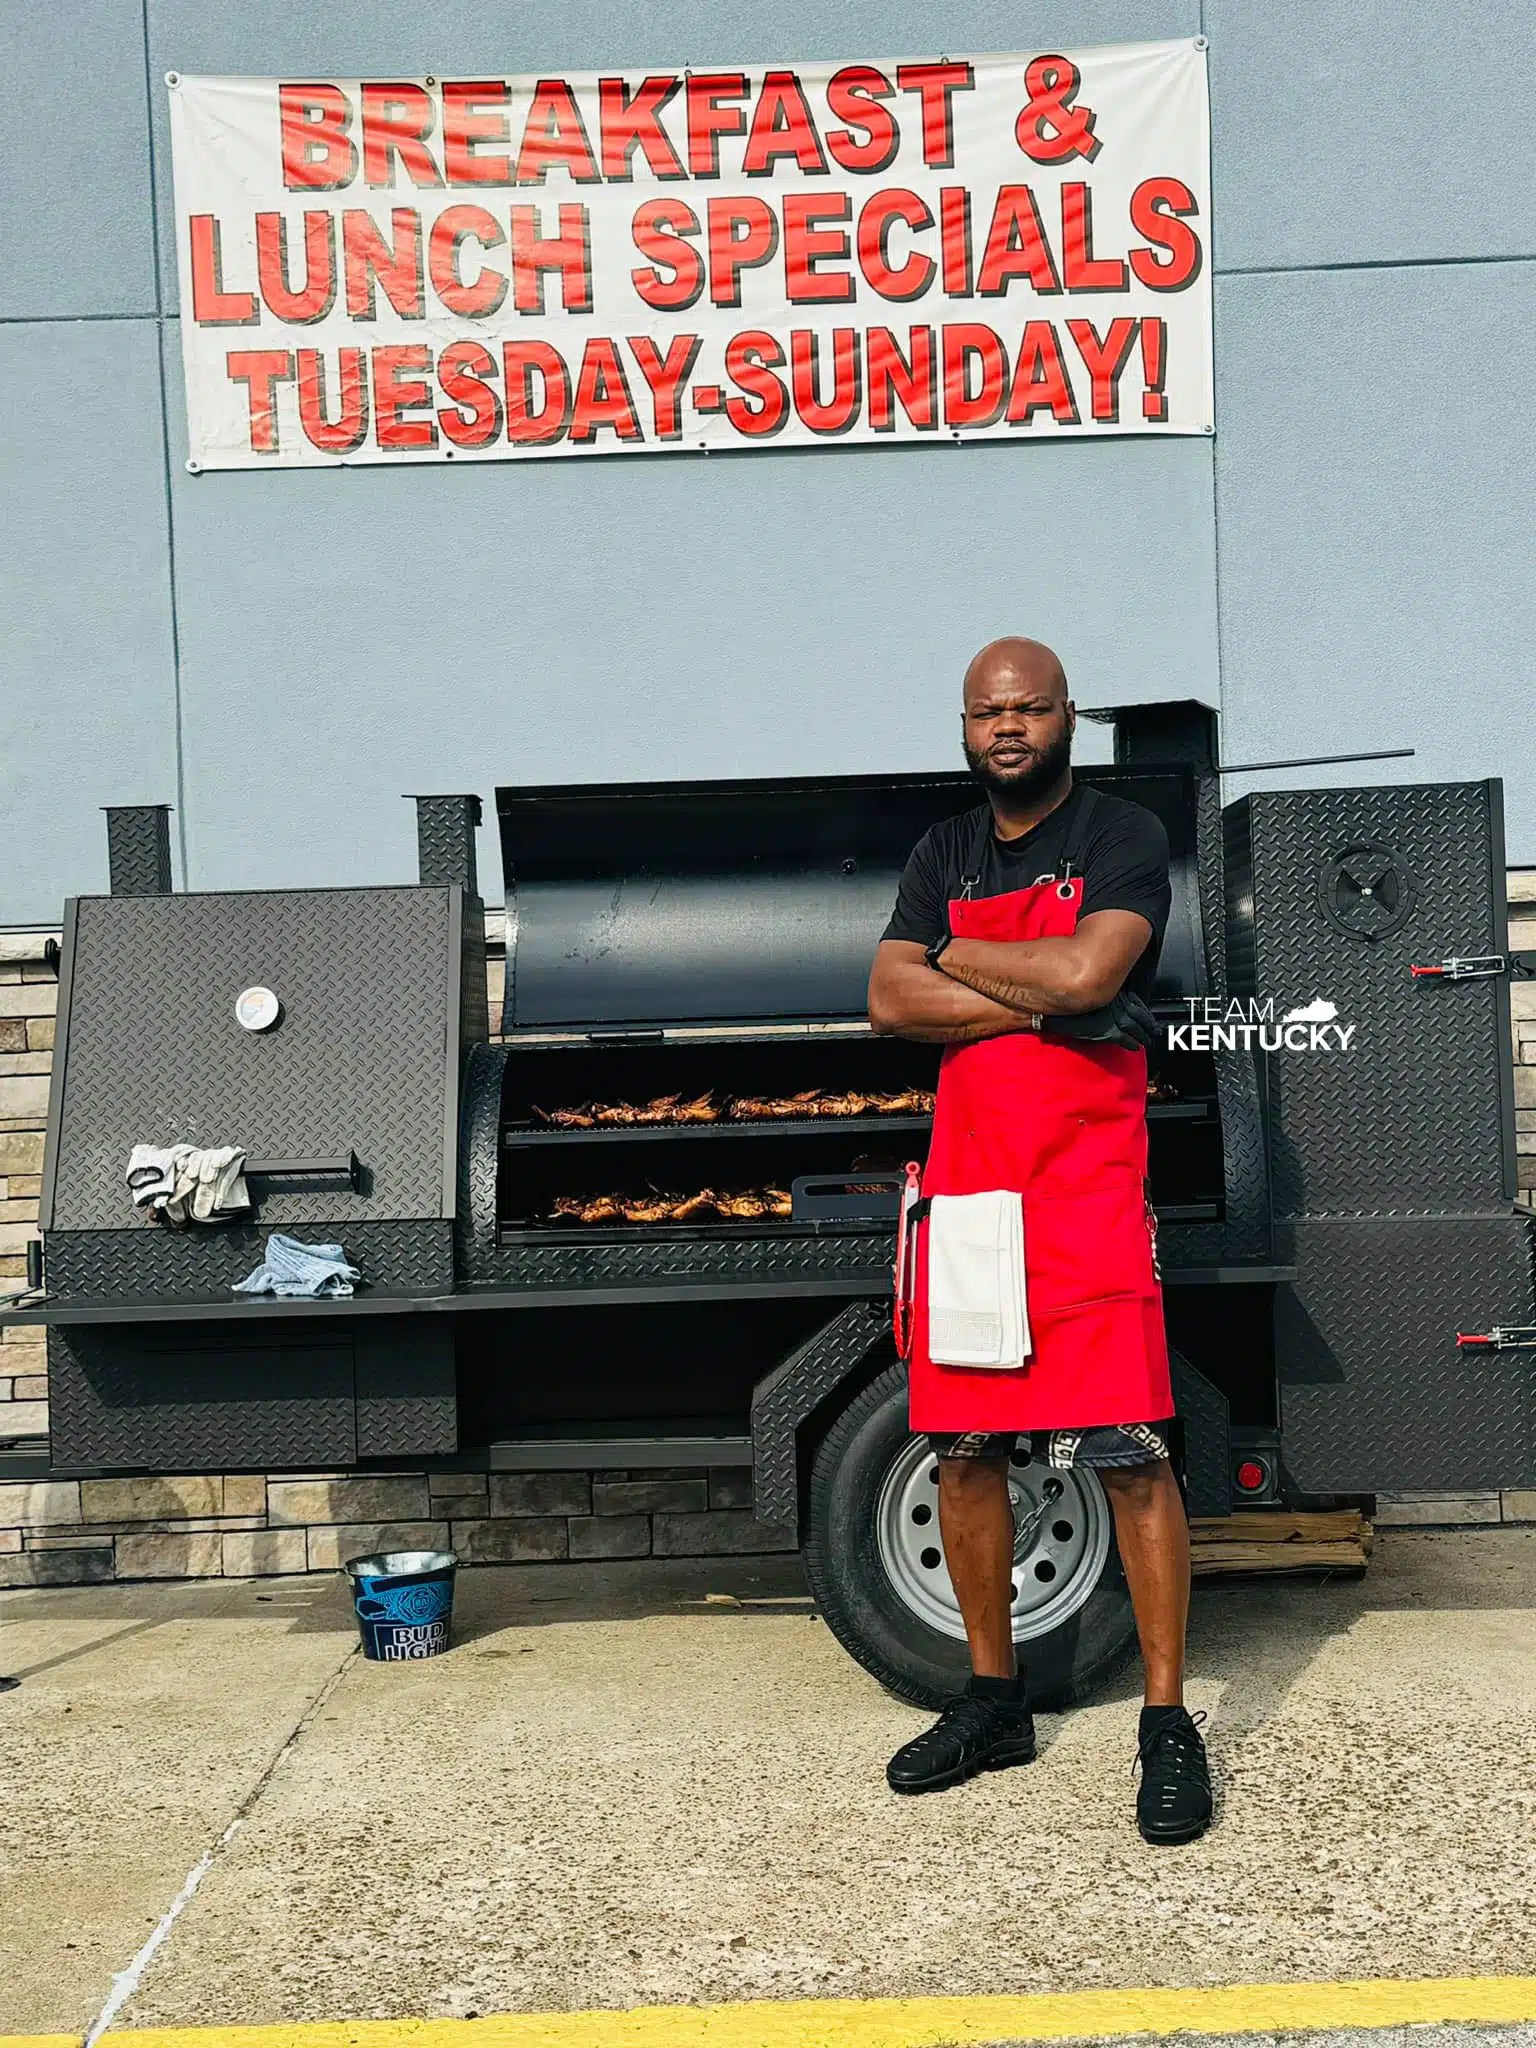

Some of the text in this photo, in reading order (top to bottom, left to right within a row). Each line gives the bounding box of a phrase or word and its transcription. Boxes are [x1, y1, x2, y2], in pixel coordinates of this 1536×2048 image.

[279, 54, 1104, 192] BREAKFAST &
[189, 176, 1202, 328] LUNCH SPECIALS
[226, 316, 1169, 456] TUESDAY-SUNDAY!
[393, 1622, 444, 1646] BUD
